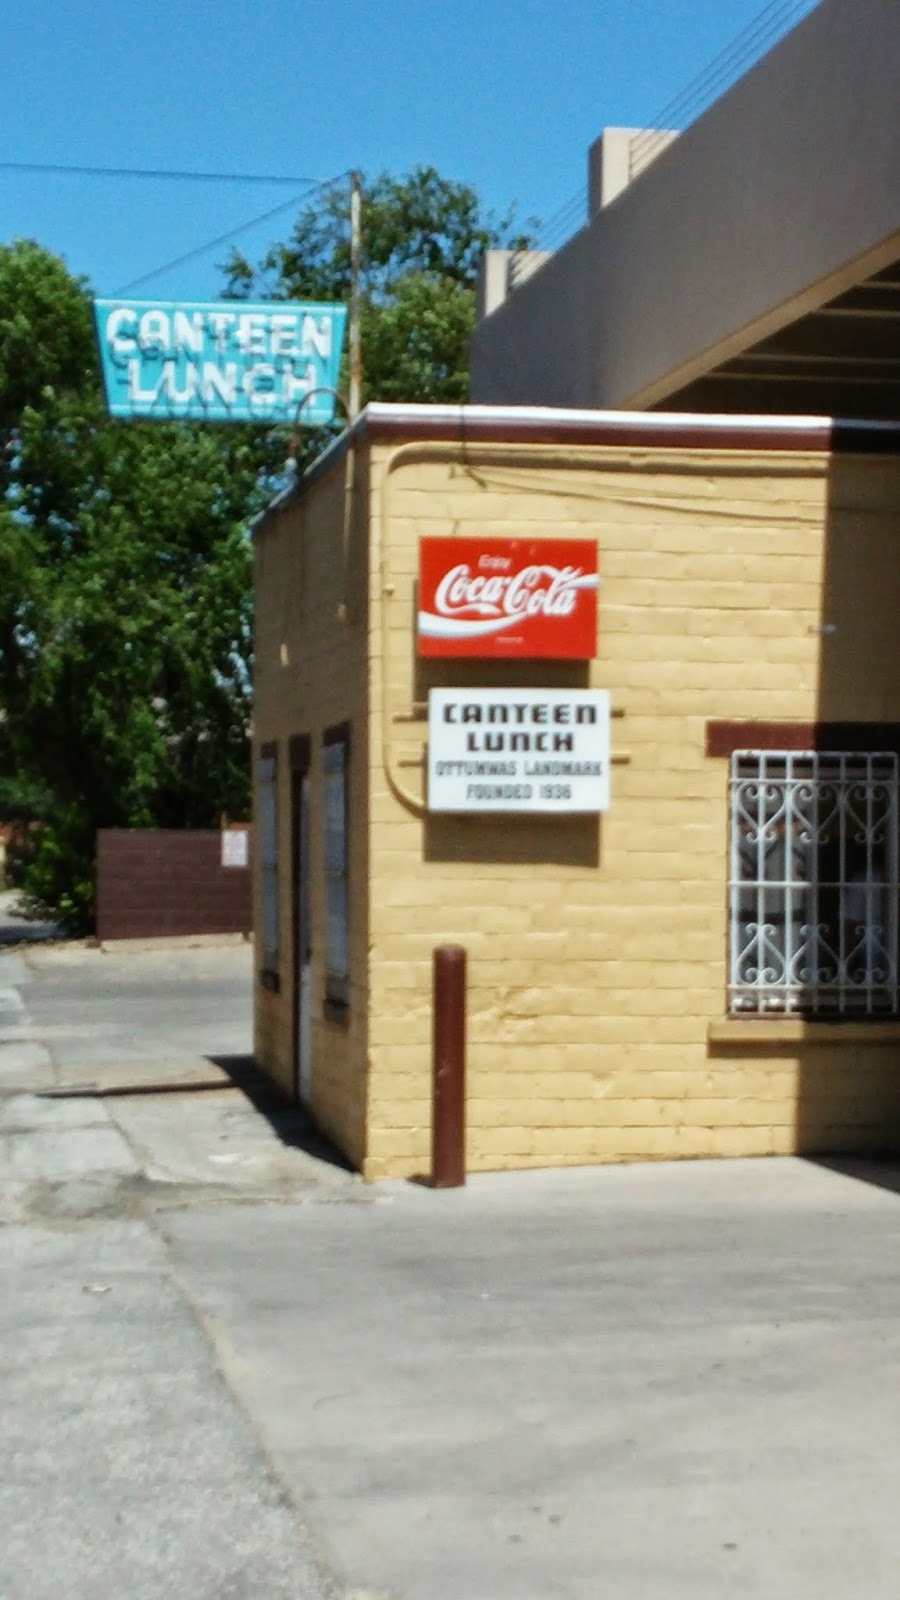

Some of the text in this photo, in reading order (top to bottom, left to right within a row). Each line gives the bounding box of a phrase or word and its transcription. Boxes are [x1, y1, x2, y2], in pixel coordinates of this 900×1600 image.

[106, 308, 332, 357] CANTEEN
[127, 358, 317, 404] LUNCH
[434, 563, 582, 616] Coca-Cola
[442, 703, 597, 724] CANTEEN
[466, 731, 574, 752] LUNCH
[524, 760, 602, 776] LANDMARK
[466, 783, 572, 799] FOUNDED 1936
